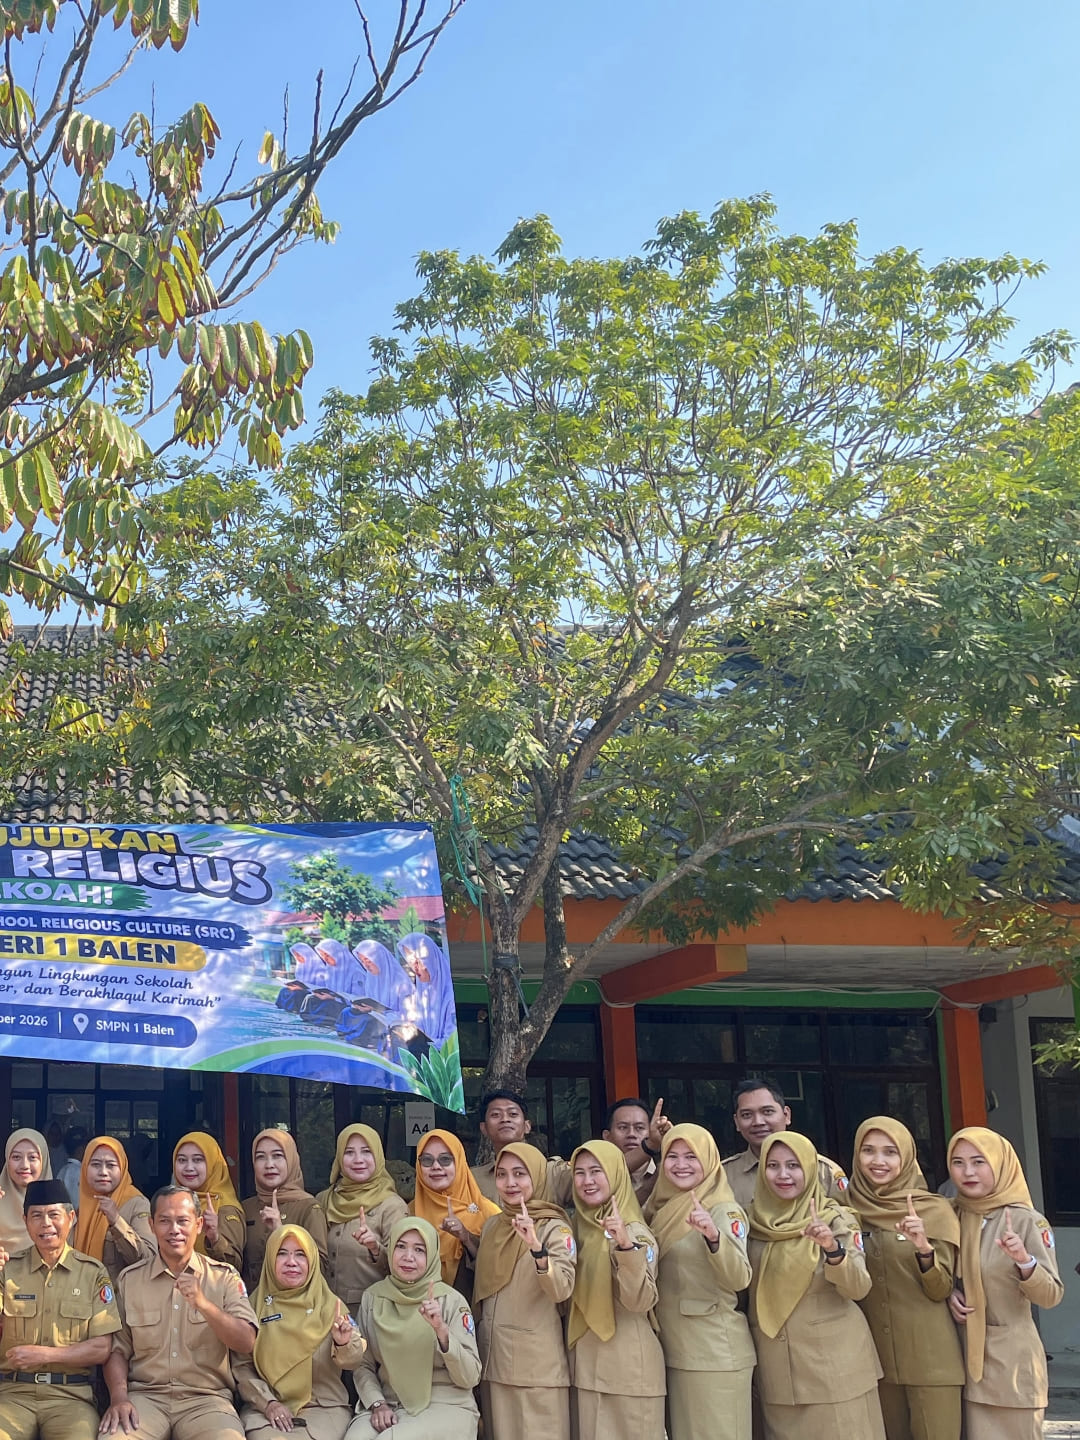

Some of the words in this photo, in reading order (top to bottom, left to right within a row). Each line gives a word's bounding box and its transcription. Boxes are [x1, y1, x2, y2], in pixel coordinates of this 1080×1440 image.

[12, 849, 268, 900] RELIGIUS
[41, 917, 120, 932] RELIGIOUS
[125, 921, 191, 936] CULTURE
[195, 924, 236, 941] (SRC)
[54, 938, 67, 955] 1
[77, 938, 176, 964] BALEN
[39, 968, 129, 986] Lingkungan
[134, 974, 194, 990] Sekolah
[24, 983, 53, 995] dan
[59, 985, 146, 1004] Berakhlaqul
[19, 1014, 48, 1026] 2026
[96, 1020, 130, 1033] SMPN
[133, 1022, 139, 1033] 1
[143, 1023, 175, 1036] Balen
[411, 1123, 429, 1134] A4
